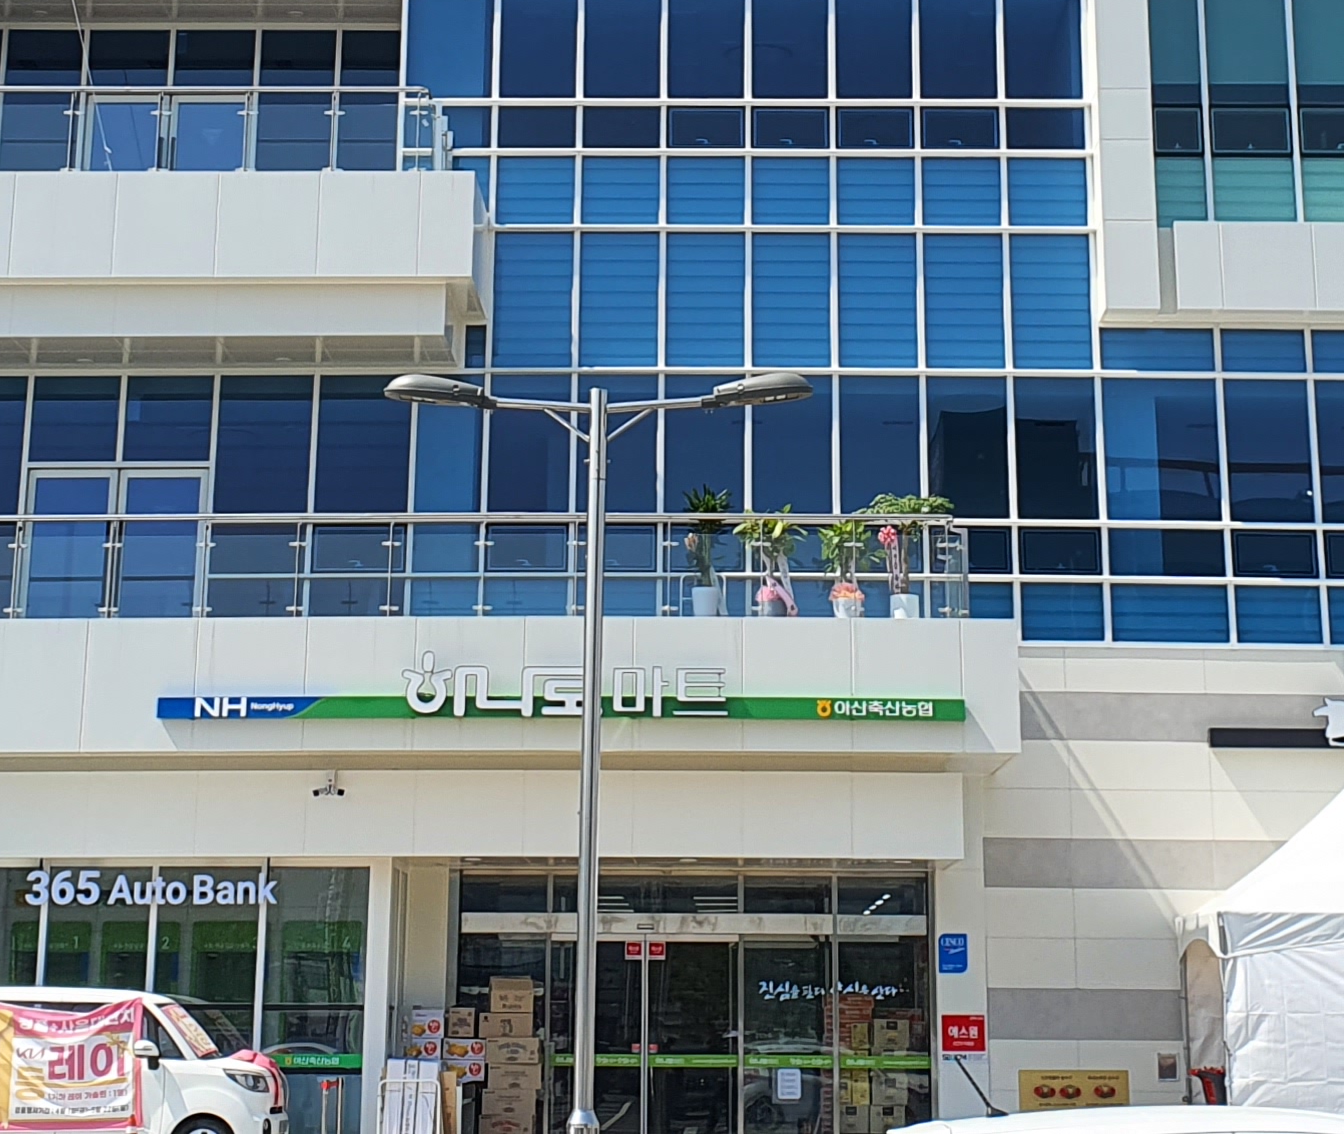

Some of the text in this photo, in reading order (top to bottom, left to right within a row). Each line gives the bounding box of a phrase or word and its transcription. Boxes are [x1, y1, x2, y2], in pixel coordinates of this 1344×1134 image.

[401, 650, 730, 718] 하나로마트
[193, 696, 247, 718] NH
[24, 869, 278, 906] 365 Auto Bank
[161, 936, 170, 950] 2
[948, 1026, 979, 1039] 에스원
